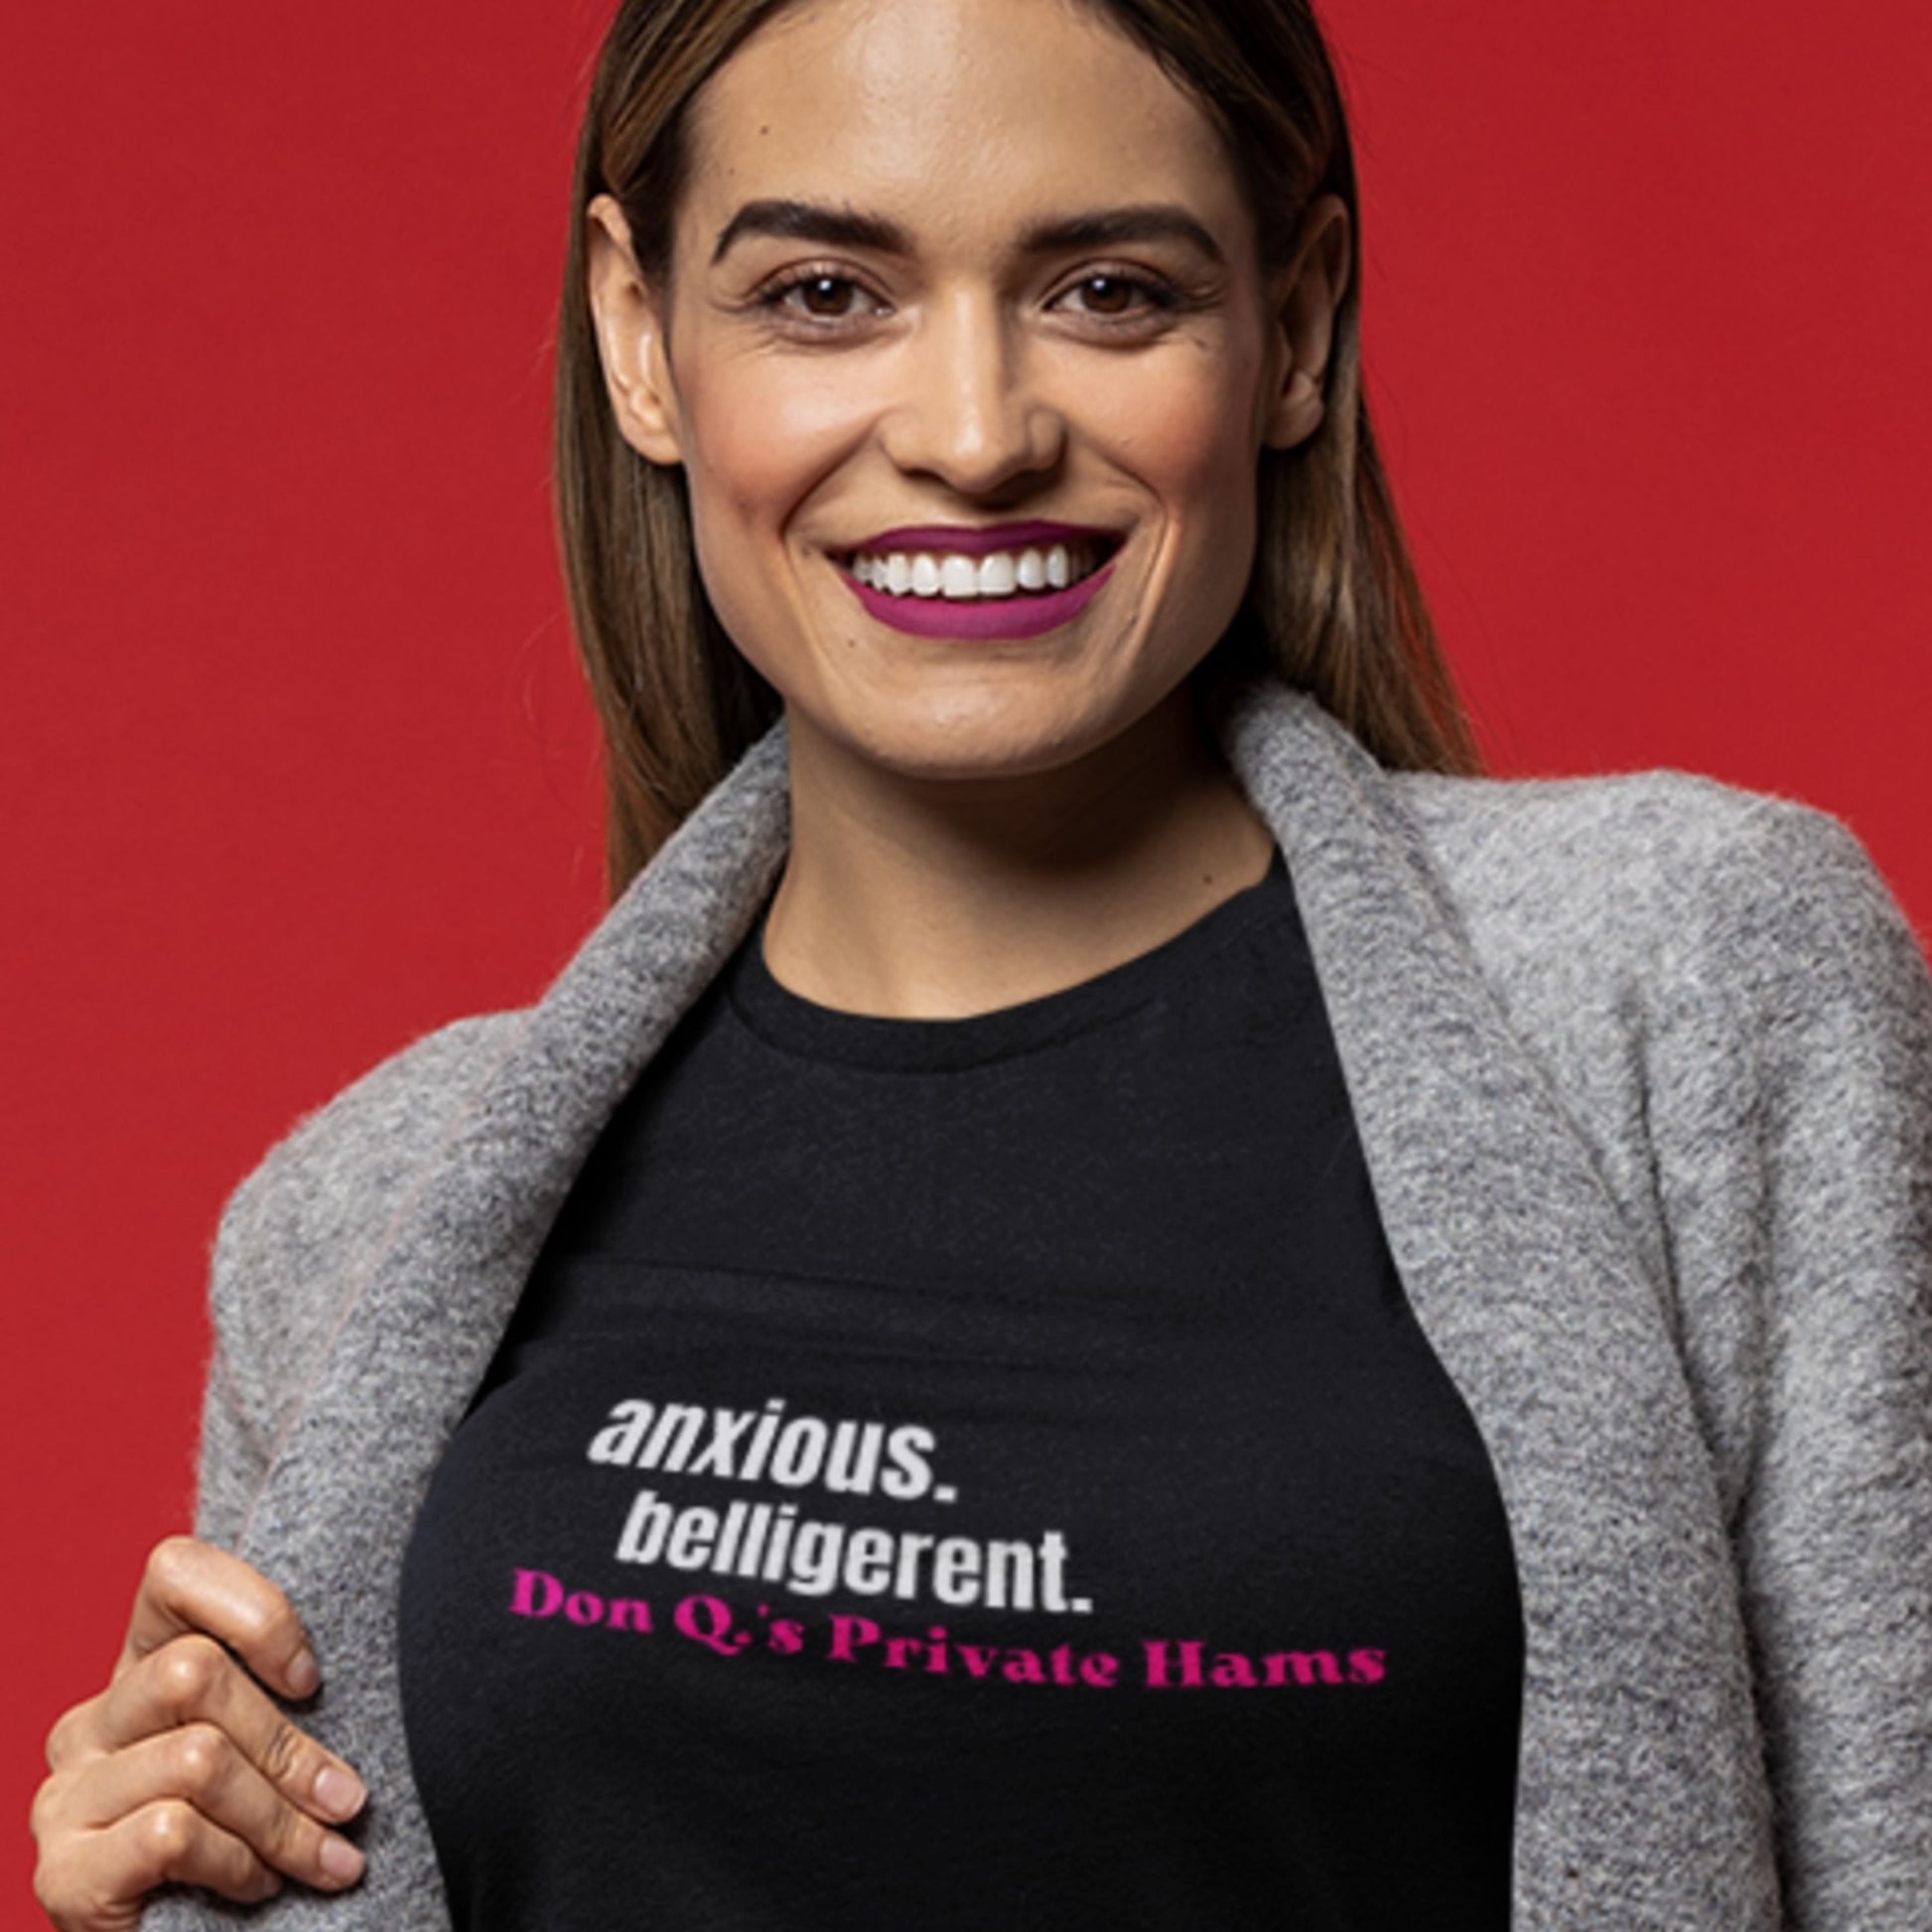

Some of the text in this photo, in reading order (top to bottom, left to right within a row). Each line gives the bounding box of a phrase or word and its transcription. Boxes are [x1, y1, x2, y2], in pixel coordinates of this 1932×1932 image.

[586, 1397, 958, 1503] anxious.
[615, 1489, 1093, 1614] belligerent.
[508, 1569, 653, 1632] Don
[827, 1614, 1120, 1688] Private
[1143, 1641, 1387, 1689] Hams
